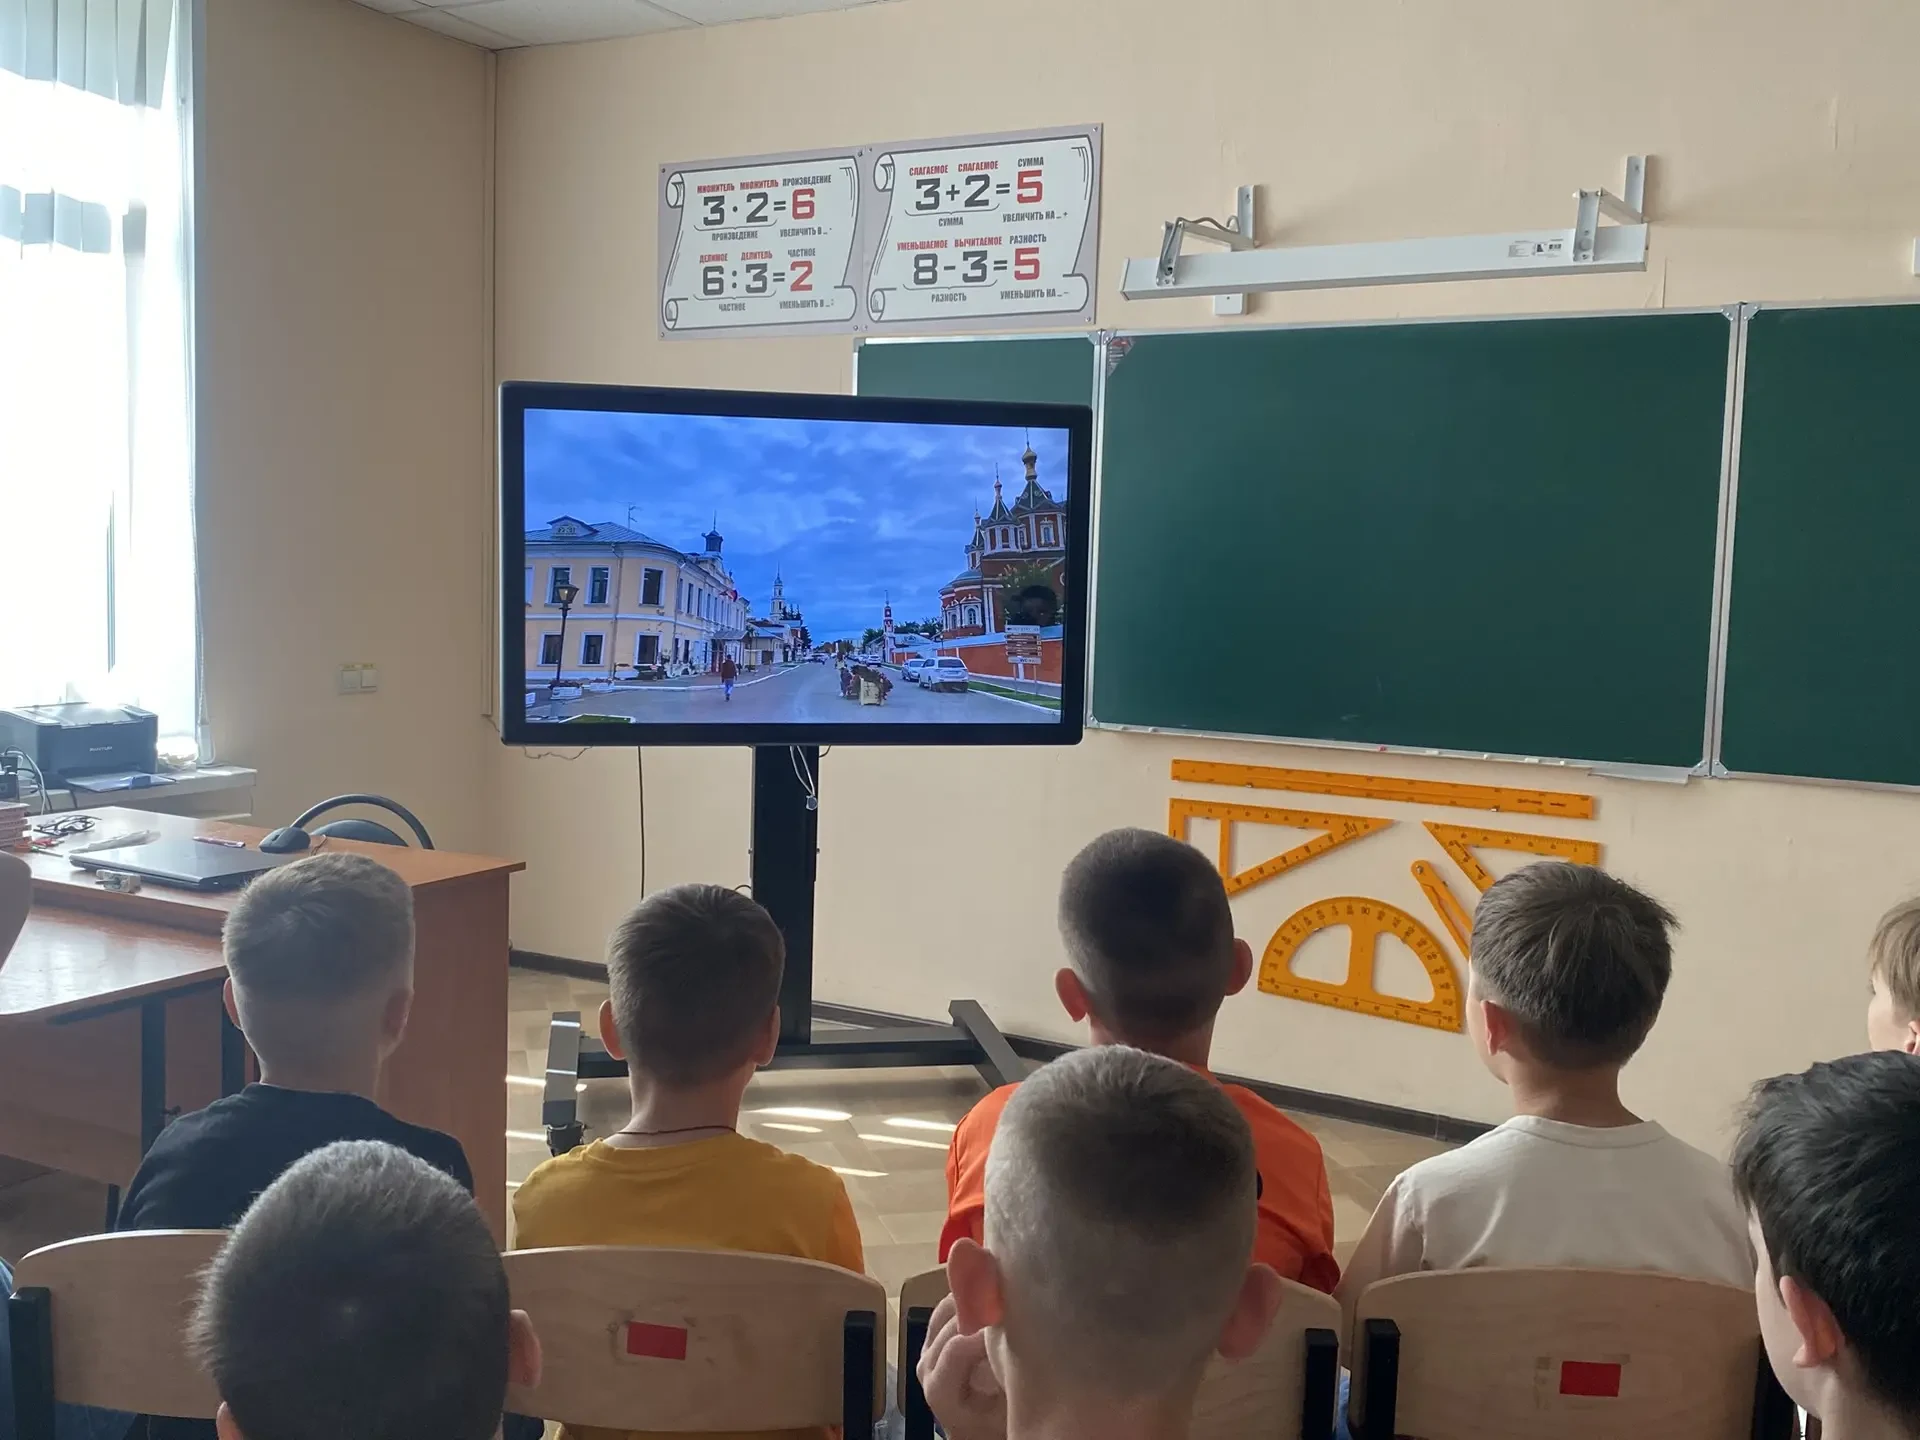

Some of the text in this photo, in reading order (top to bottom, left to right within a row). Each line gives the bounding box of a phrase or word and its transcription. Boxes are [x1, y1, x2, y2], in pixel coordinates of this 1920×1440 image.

[909, 156, 1044, 176] СЛАГАЕМОЕ СЛАГАЕМОЕ СУММА
[697, 174, 832, 193] МНОЖИТЕЛЬ МНОЖИТЕЛЬ ПРОИЗВЕДЕНИЕ
[938, 216, 963, 227] СУММА
[1002, 211, 1044, 223] УВЕЛИЧИТЬ
[712, 230, 758, 241] ПРОИЗВЕДЕНИЕ
[780, 227, 816, 238] УВЕЛИЧИТЬ
[897, 233, 1047, 251] УМЕНЬШАЕМОЕ ВЫЧИТАЕМОЕ РАЗНОСТЬ
[699, 248, 816, 264] ДЕЛИМОЕ ДЕЛИТЕЛЬ ЧАСТНОЕ
[931, 293, 967, 303] РАЗНОСТЬ
[1000, 289, 1044, 300] УМЕНЬШИТЬ
[719, 302, 746, 312] ЧАСТНОЕ
[779, 300, 818, 309] УМЕНЬШИТЬ
